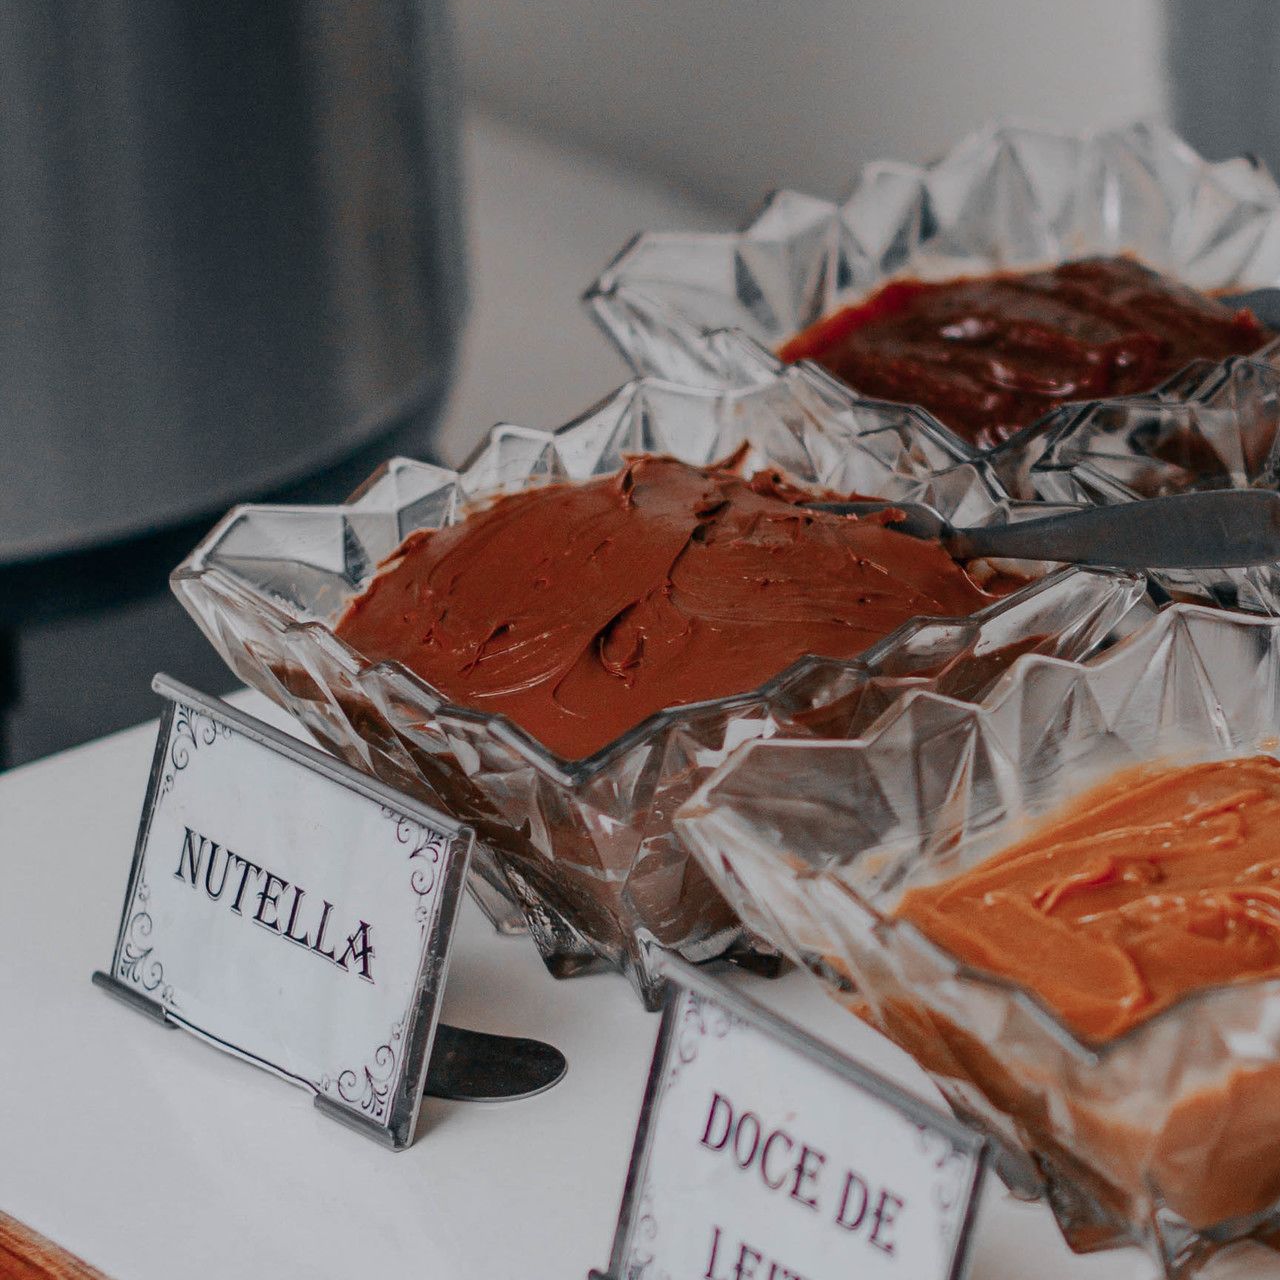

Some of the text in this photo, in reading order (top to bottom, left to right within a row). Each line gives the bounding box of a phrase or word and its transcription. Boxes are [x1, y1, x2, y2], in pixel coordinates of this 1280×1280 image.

[174, 826, 375, 984] NUTELLA
[700, 1091, 904, 1255] DOCE DE
